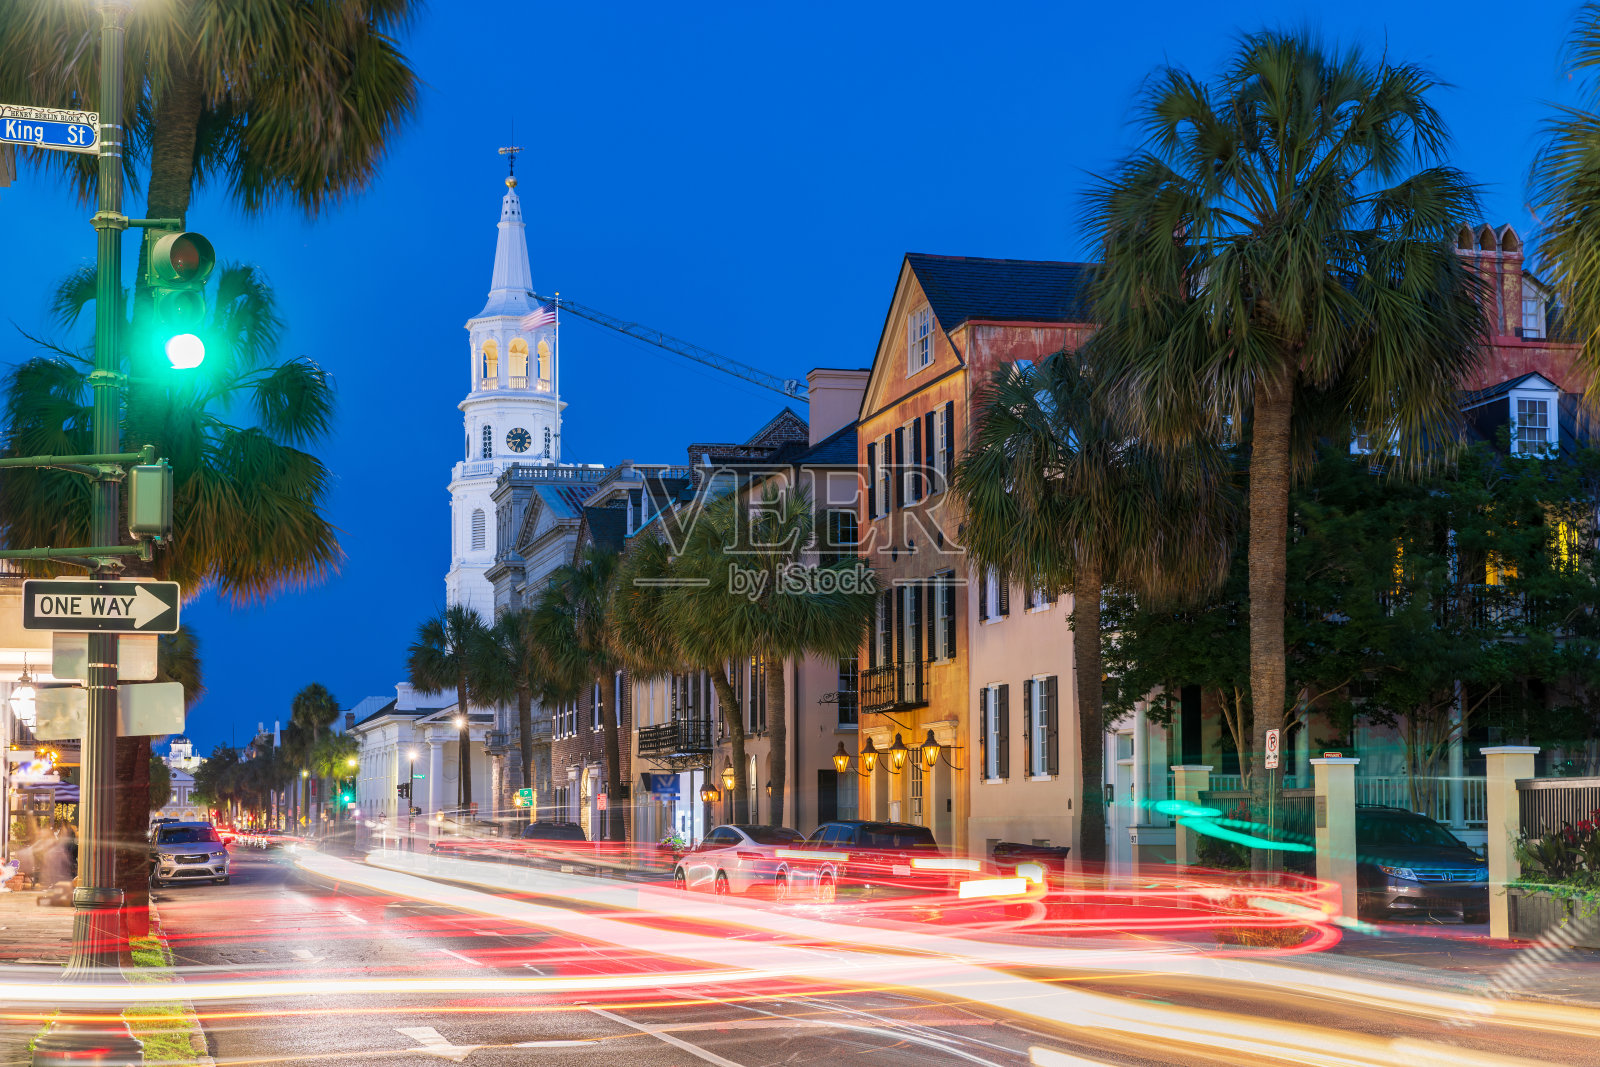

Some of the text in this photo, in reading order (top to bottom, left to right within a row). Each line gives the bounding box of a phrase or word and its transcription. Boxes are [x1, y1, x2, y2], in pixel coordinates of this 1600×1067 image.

[10, 110, 33, 118] HENRY
[34, 112, 58, 121] BERLIN
[5, 119, 86, 145] King St
[40, 596, 135, 616] ONE WAY
